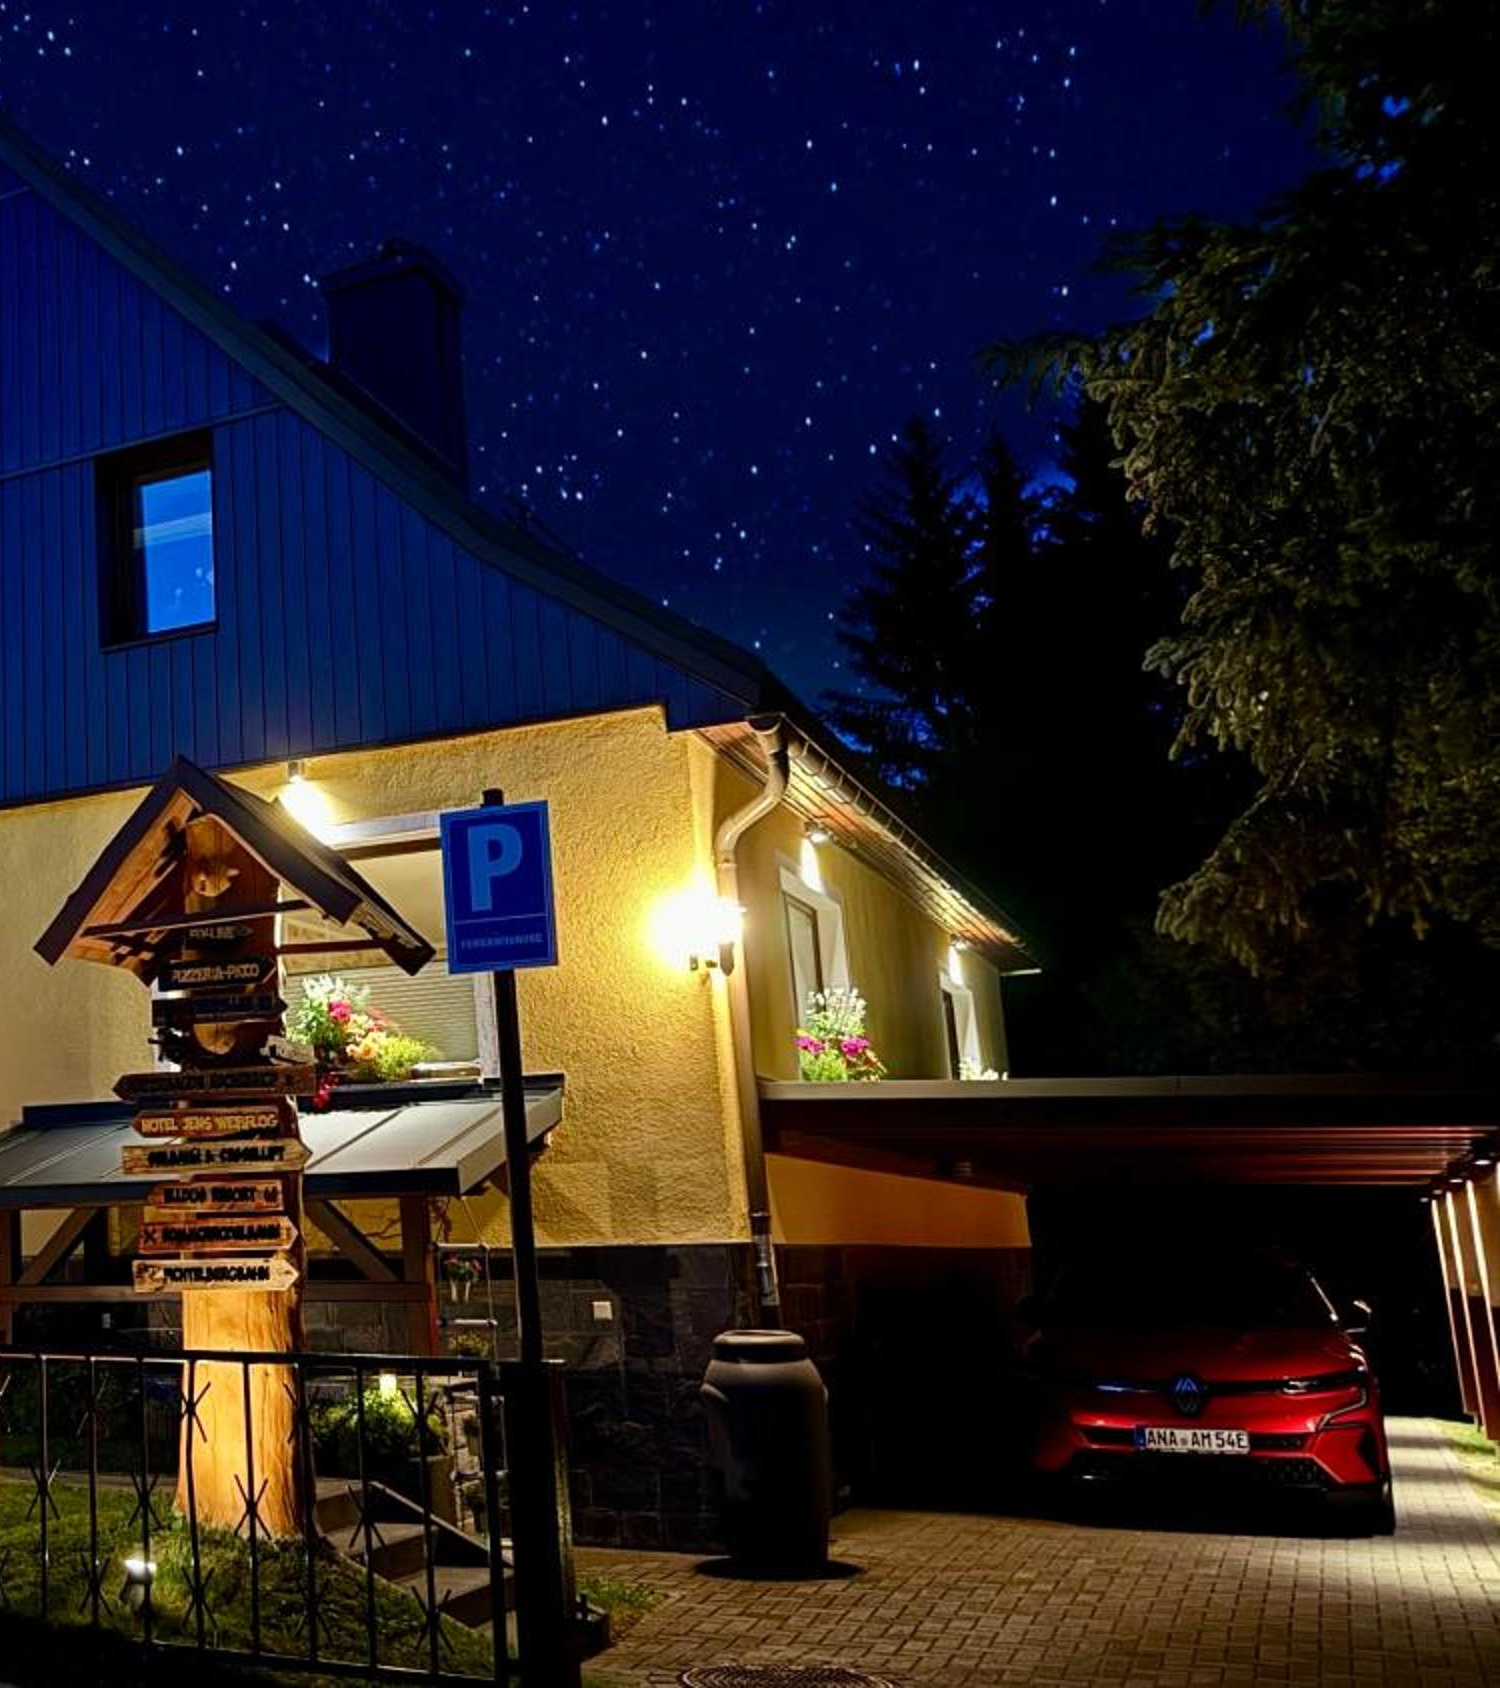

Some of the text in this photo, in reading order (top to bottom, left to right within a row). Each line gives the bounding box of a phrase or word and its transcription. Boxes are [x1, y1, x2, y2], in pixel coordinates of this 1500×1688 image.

[468, 823, 523, 912] P
[141, 1116, 178, 1133] HOTEL
[1147, 1429, 1248, 1448] ANA AM 54E
